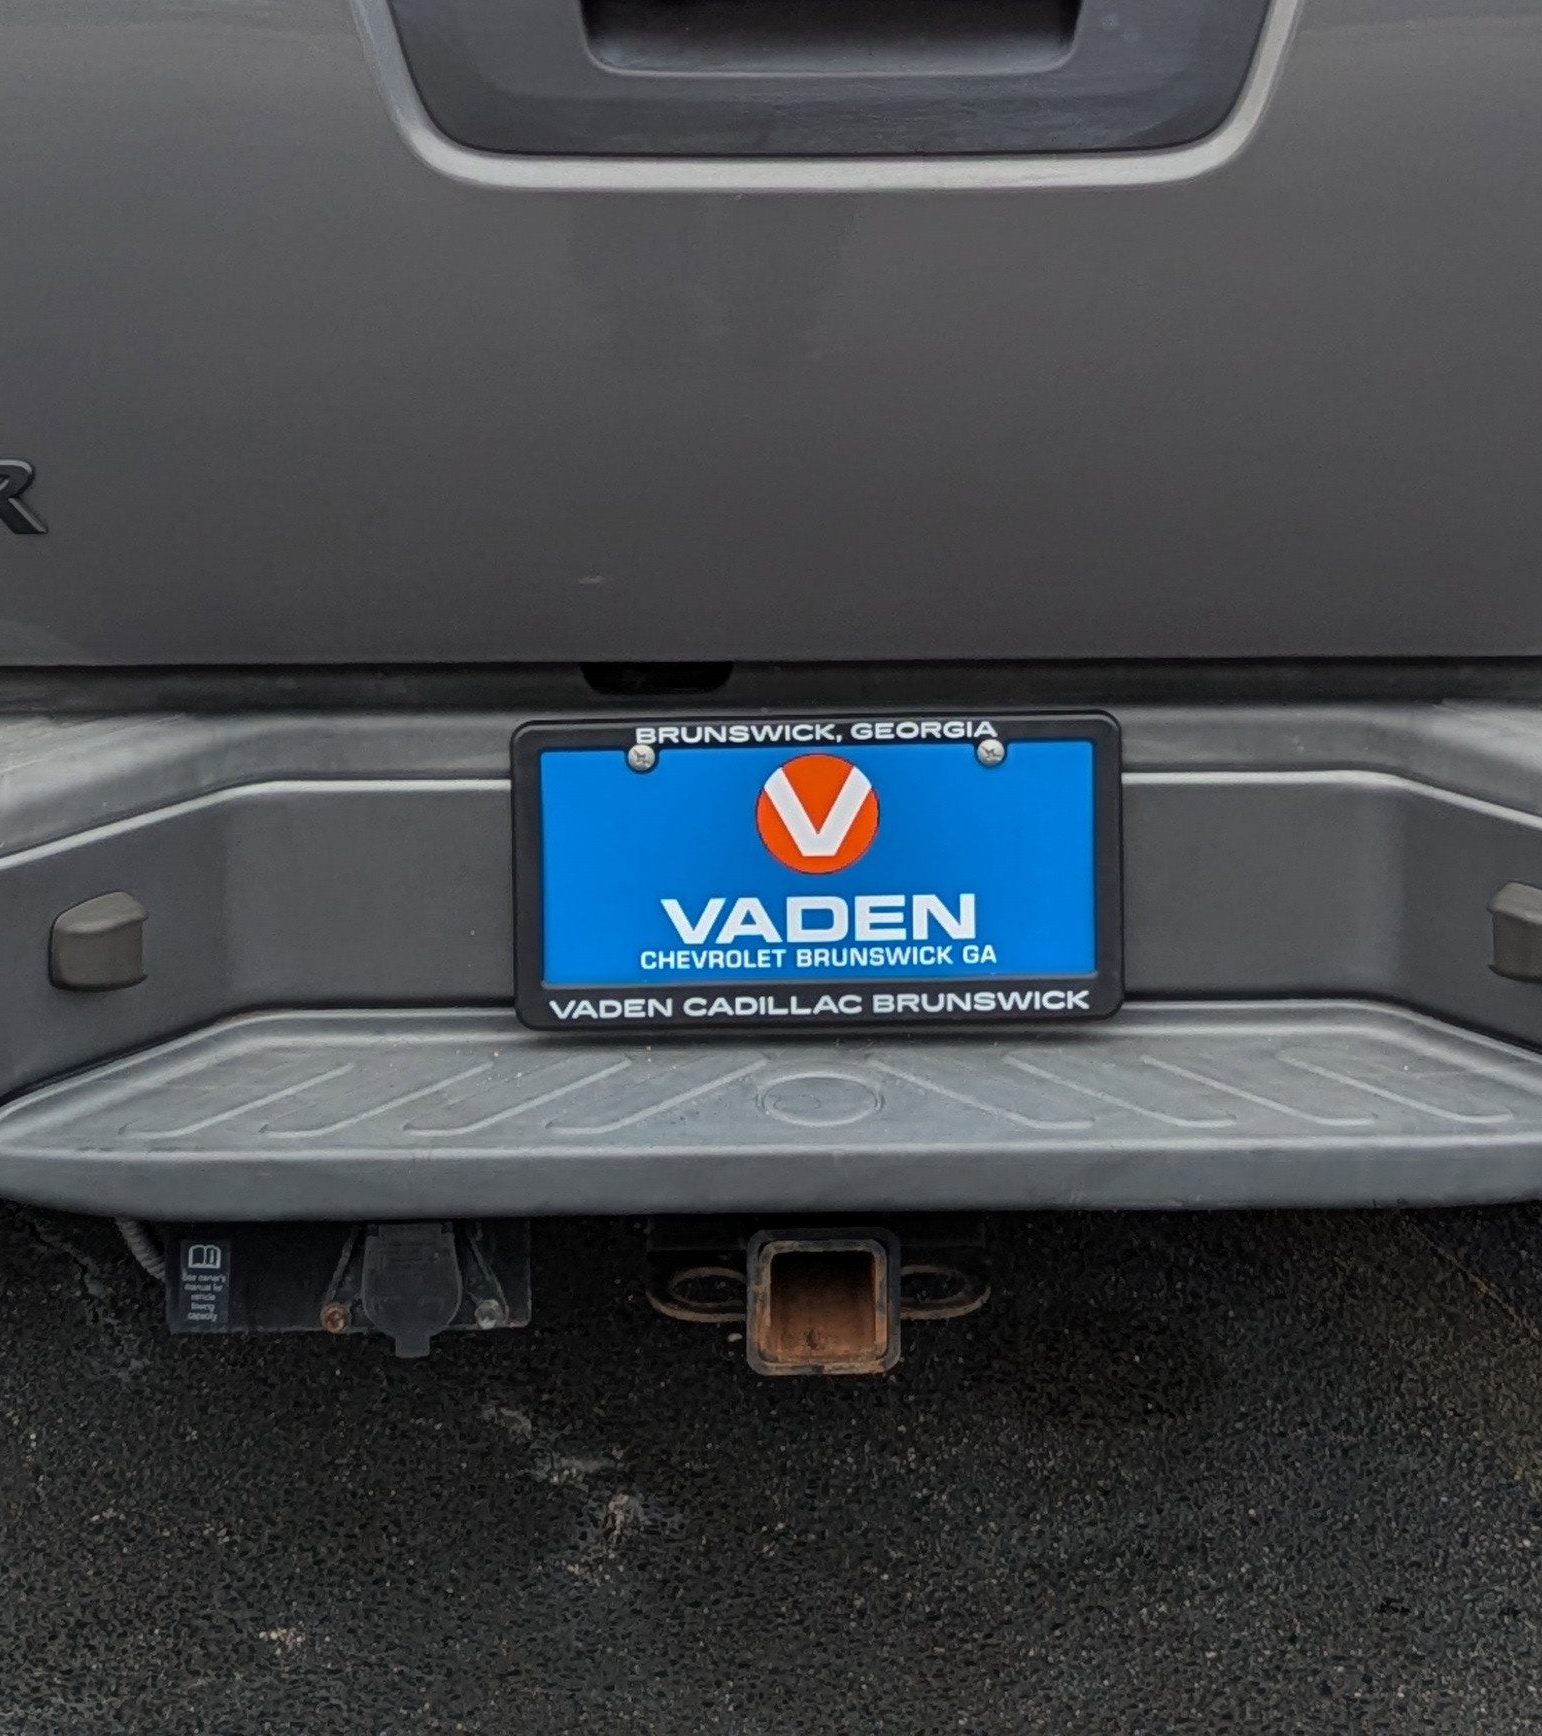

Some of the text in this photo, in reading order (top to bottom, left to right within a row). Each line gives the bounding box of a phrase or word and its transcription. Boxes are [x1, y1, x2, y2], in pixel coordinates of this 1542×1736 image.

[636, 720, 999, 745] BRUNSWICK, GEORGIA
[763, 766, 873, 857] V
[661, 893, 977, 945] VADEN
[640, 945, 998, 970] CHEVROLET BRUNSWICK GA
[549, 990, 1091, 1020] VADEN CADILLAC BRUNSWICK
